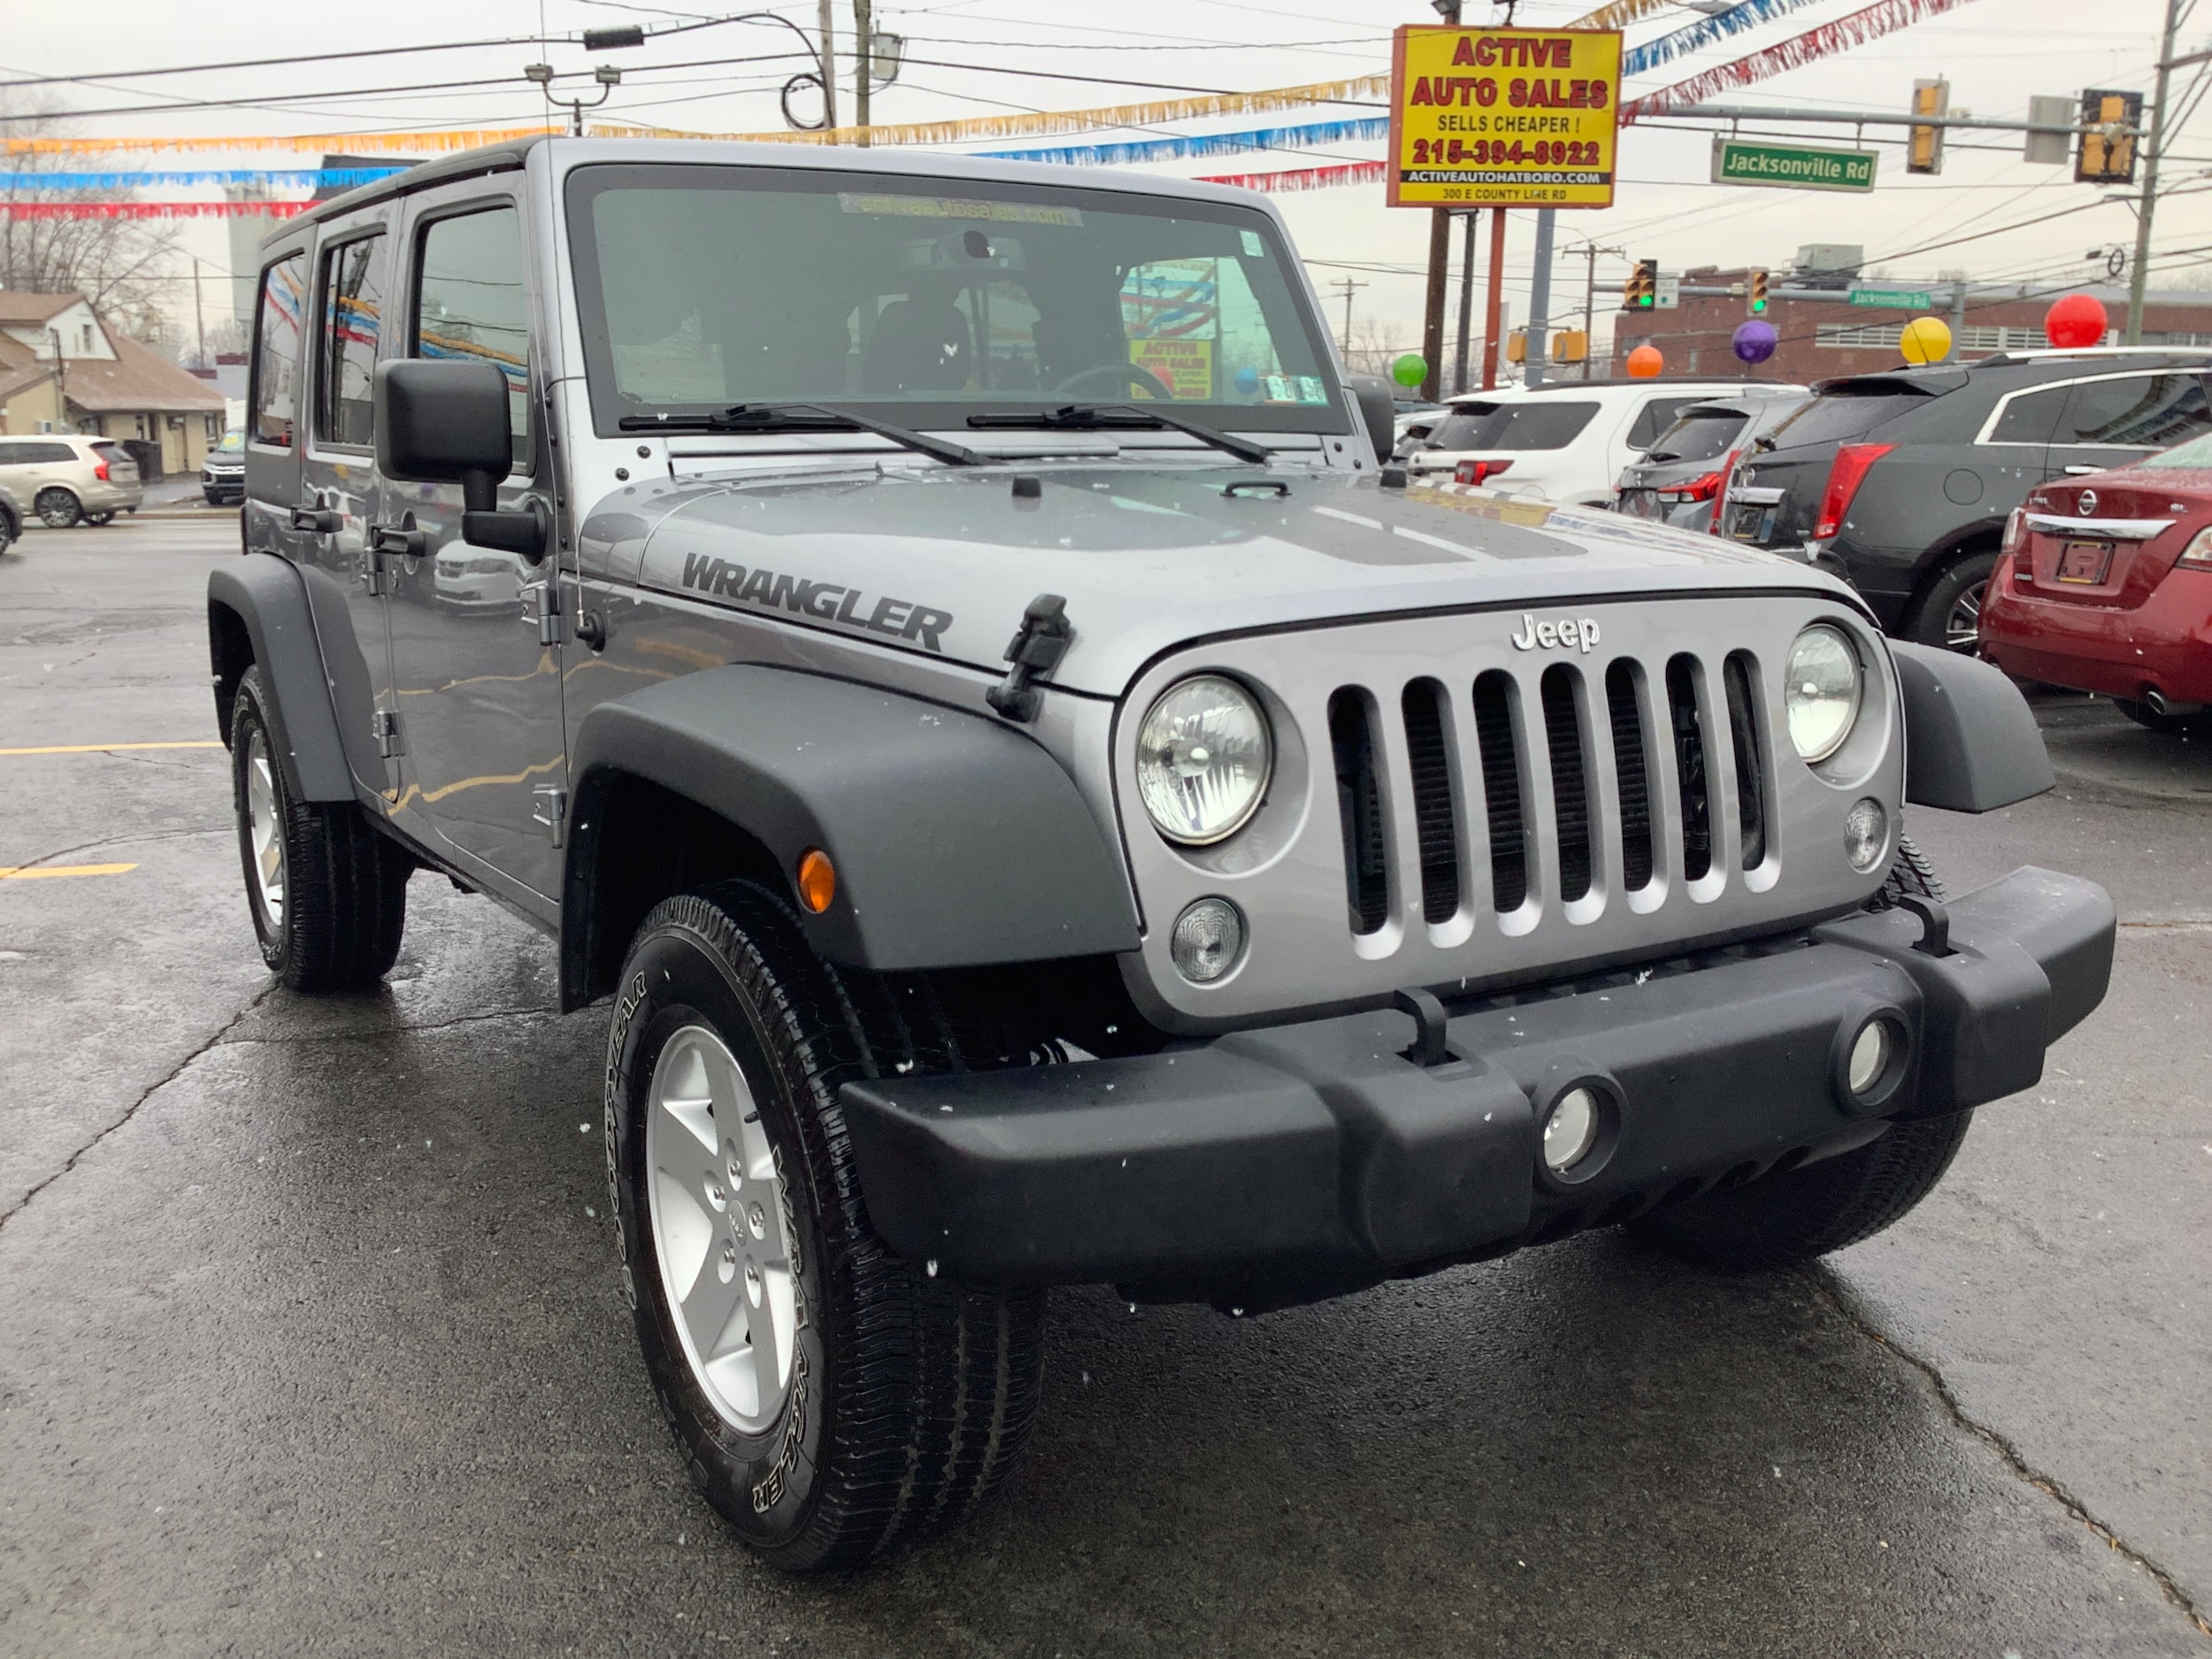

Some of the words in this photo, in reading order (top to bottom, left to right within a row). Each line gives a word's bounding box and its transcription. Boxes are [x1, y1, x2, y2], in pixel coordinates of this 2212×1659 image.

[1452, 36, 1571, 68] ACTIVE
[1410, 77, 1497, 106] AUTO
[1509, 79, 1608, 109] SALES
[1438, 115, 1487, 131] SELLS
[1494, 116, 1570, 133] CHEAPER
[1412, 139, 1600, 165] 215-394-8922
[1409, 171, 1600, 183] ACTIVEAUTOHATBORO.COM
[1727, 153, 1841, 177] Jacksonville
[1846, 161, 1870, 180] Rd
[1443, 188, 1460, 199] 300
[1465, 188, 1471, 199] E
[1475, 188, 1520, 200] COUNTY
[1524, 189, 1548, 200] LINE
[1552, 189, 1566, 200] RD
[1854, 291, 1912, 306] Jacksonville
[1913, 294, 1927, 307] Rd
[681, 552, 954, 652] WRANGLER
[1510, 613, 1601, 654] Jeep
[604, 969, 647, 1311] GOODYEAR
